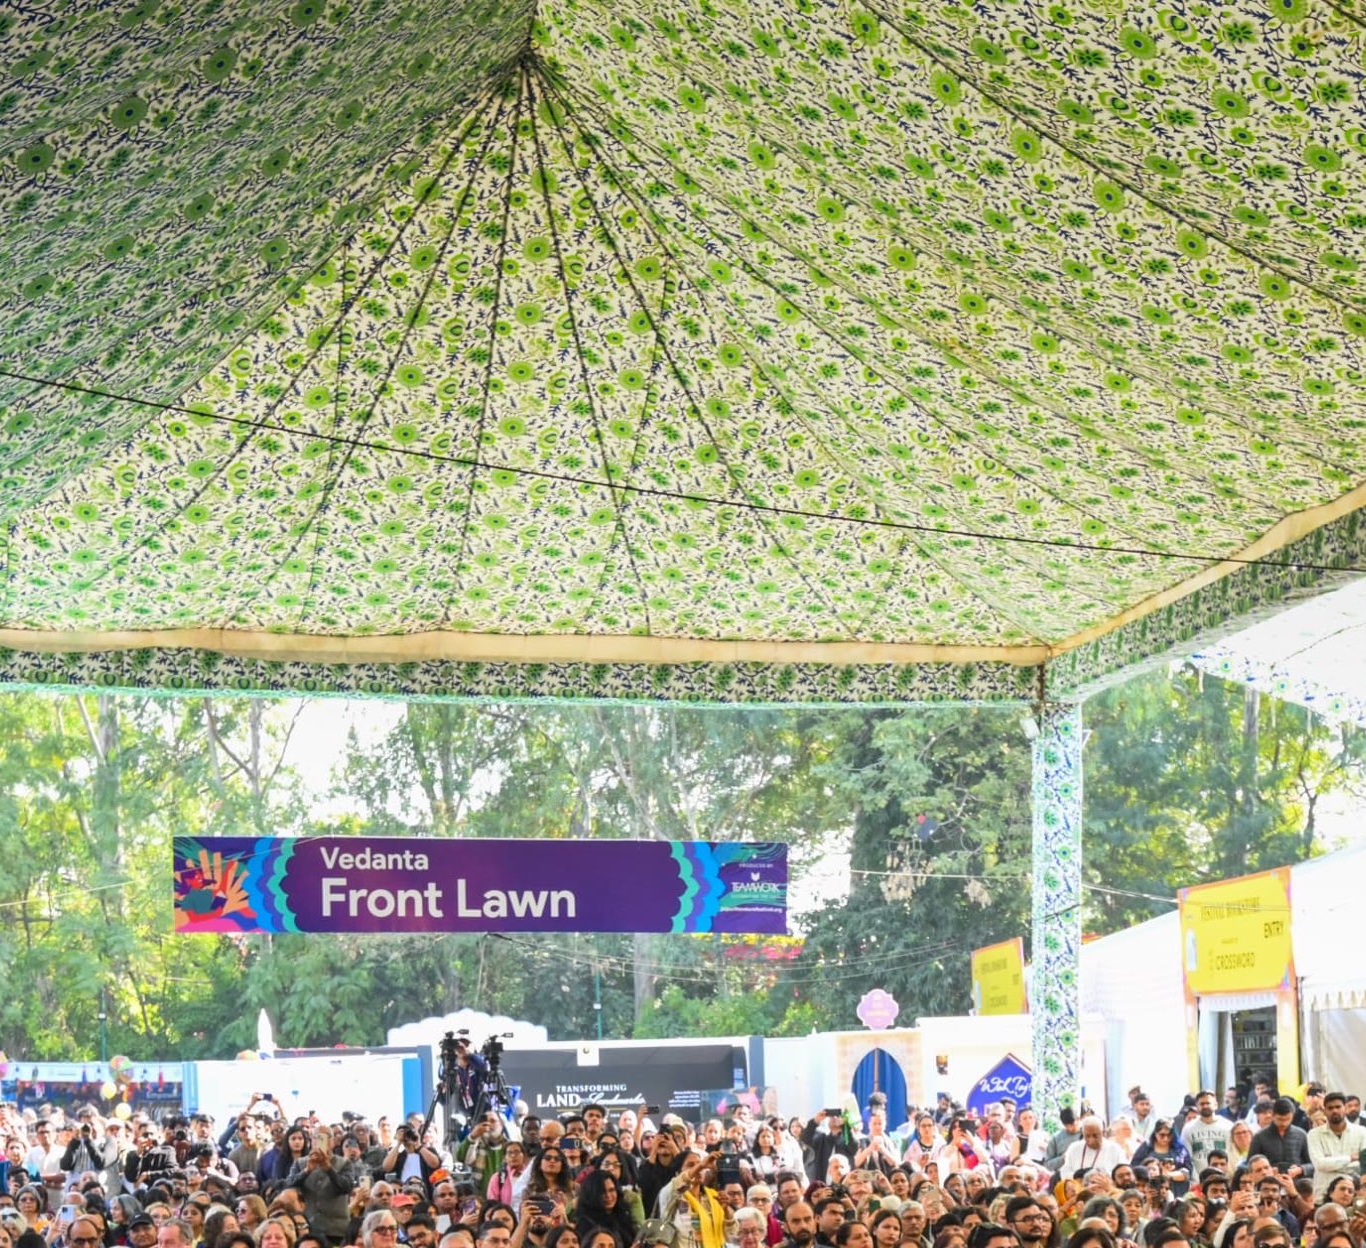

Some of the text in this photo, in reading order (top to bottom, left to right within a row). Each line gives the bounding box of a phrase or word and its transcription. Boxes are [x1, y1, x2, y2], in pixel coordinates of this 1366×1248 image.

[320, 846, 429, 871] Vedanta
[731, 882, 781, 893] TEAMWORK
[321, 876, 577, 918] Front Lawn
[1263, 920, 1284, 938] ENTRY
[1216, 952, 1255, 970] CROSSWORD
[556, 1083, 627, 1093] TRANSFORMING
[537, 1093, 580, 1108] LAND
